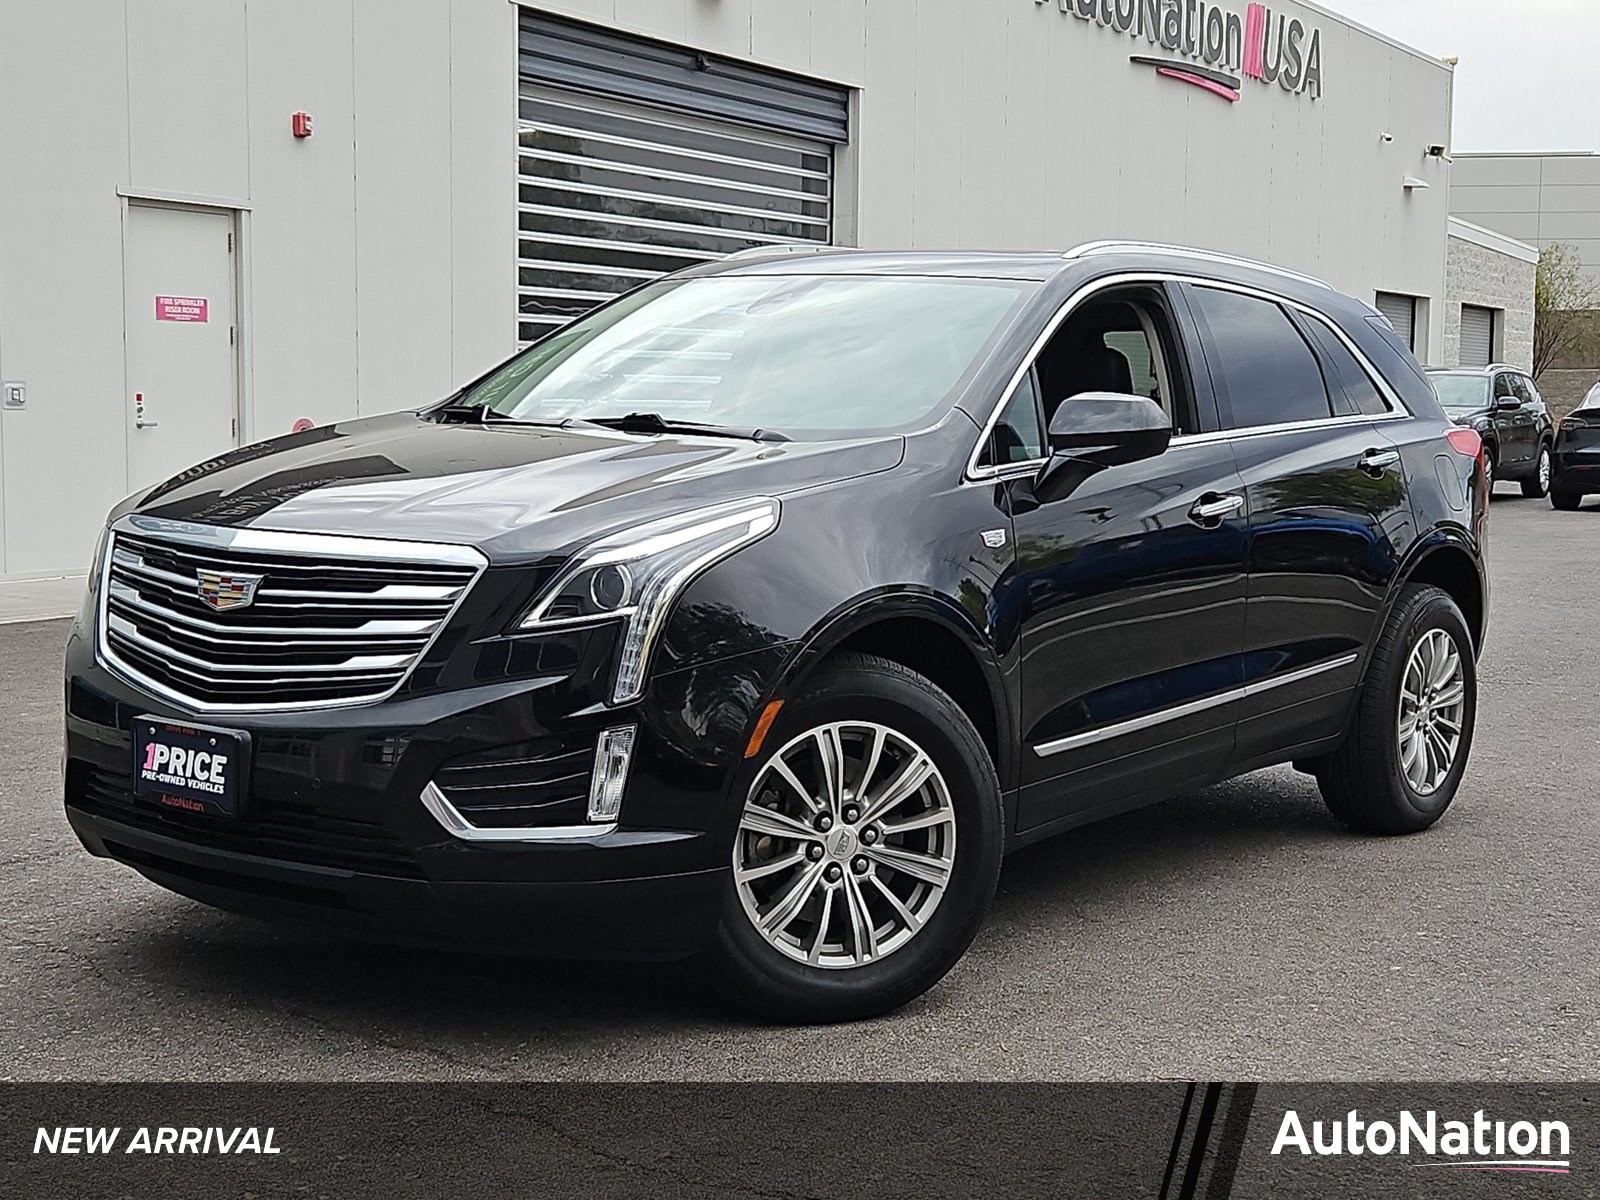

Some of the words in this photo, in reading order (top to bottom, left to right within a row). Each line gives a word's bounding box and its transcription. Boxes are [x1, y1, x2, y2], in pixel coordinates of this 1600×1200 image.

[1262, 8, 1322, 99] USA
[182, 306, 201, 314] ROOM
[143, 742, 228, 784] 1PRICE
[141, 769, 186, 786] PRE-OWNED
[187, 778, 225, 795] VEHICLES
[161, 794, 204, 812] AutoNation
